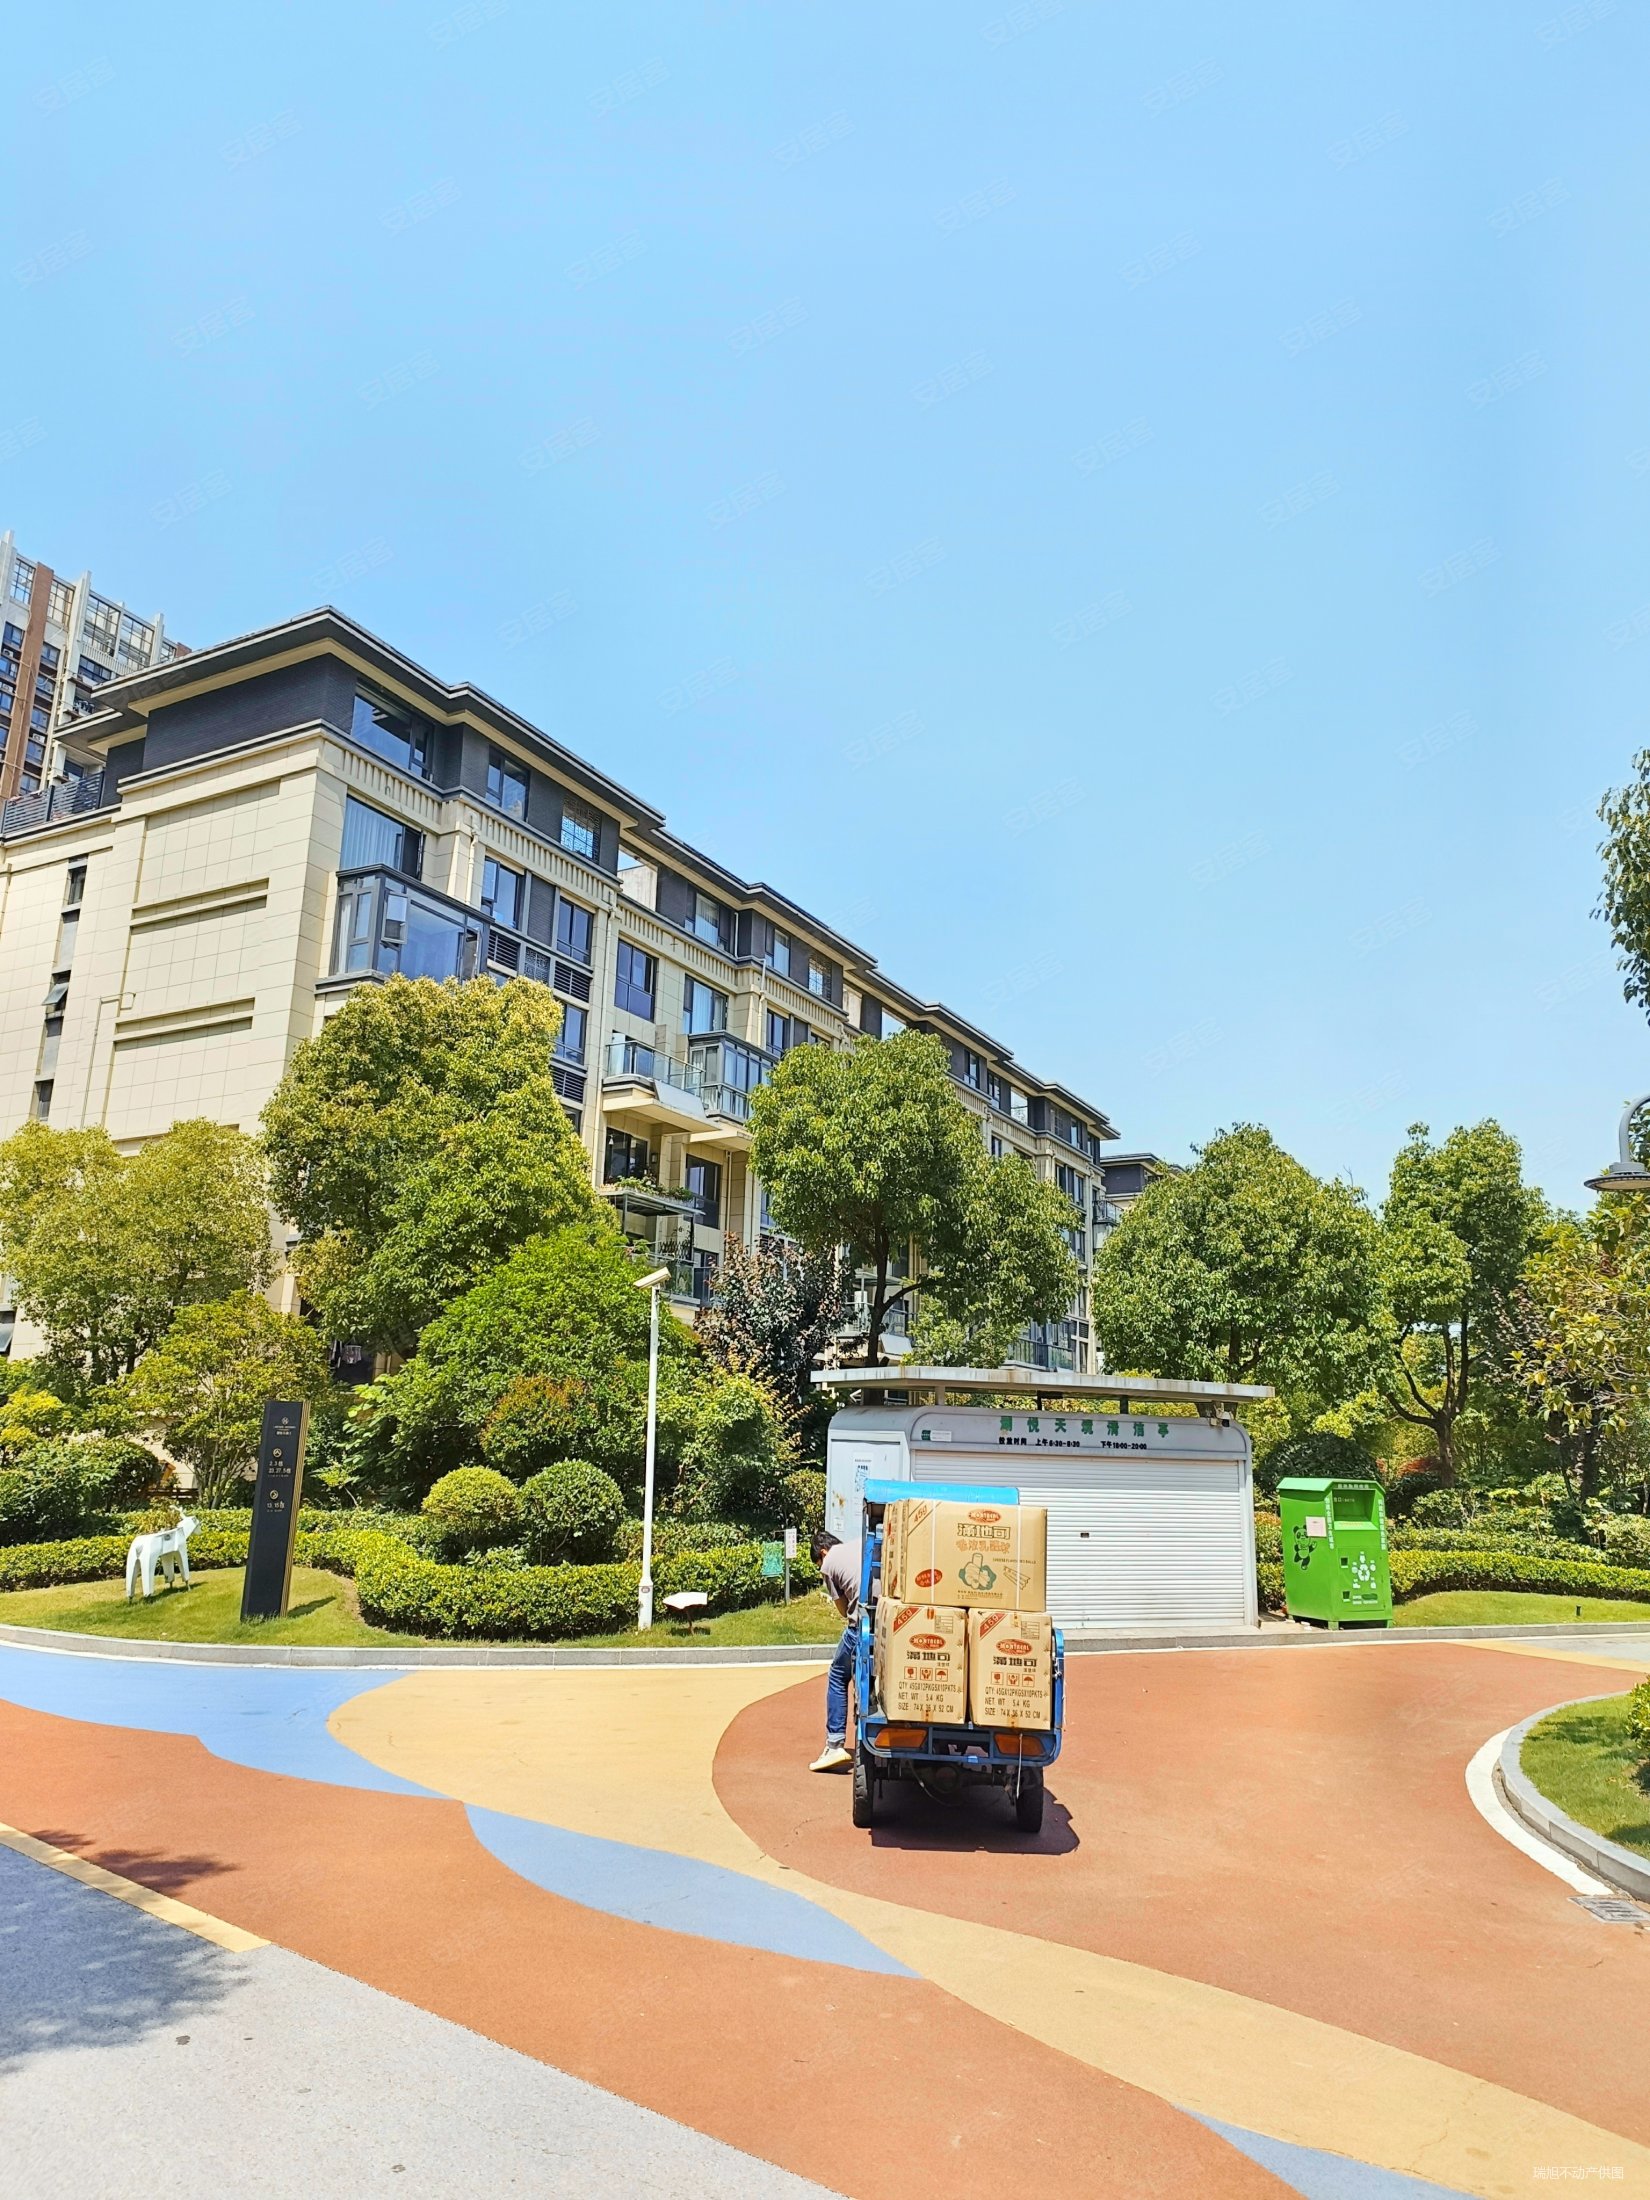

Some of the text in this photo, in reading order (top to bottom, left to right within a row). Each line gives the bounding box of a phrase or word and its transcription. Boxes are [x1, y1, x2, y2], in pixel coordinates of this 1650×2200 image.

[898, 1692, 908, 1700] NET
[936, 1694, 944, 1702] KG
[1023, 1699, 1030, 1708] KG
[946, 1705, 954, 1713] CM
[1033, 1710, 1040, 1719] CM
